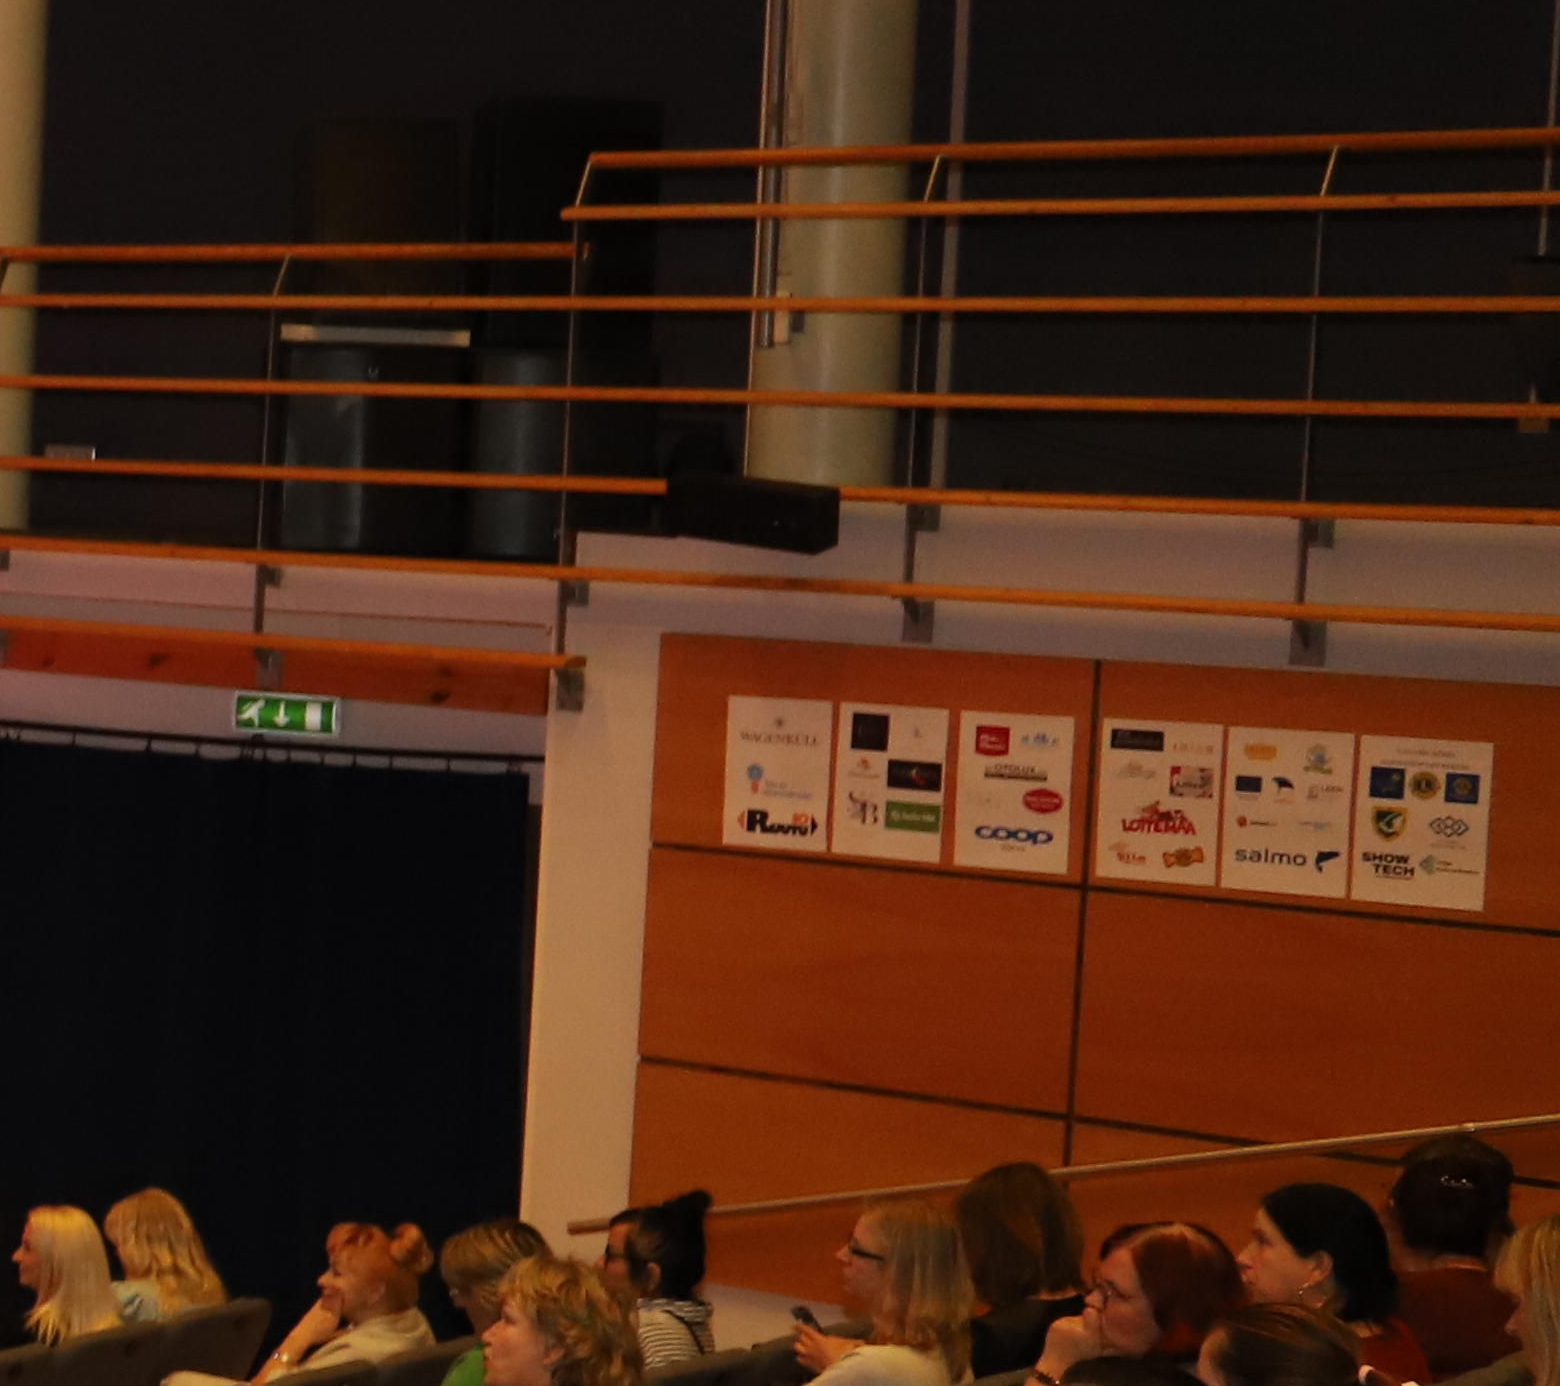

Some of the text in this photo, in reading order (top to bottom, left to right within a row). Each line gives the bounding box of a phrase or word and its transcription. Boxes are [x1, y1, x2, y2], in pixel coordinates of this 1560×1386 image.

[975, 825, 1054, 845] coop
[1235, 846, 1308, 867] salmo
[1362, 851, 1410, 864] SHOW
[1373, 863, 1415, 877] TECH
